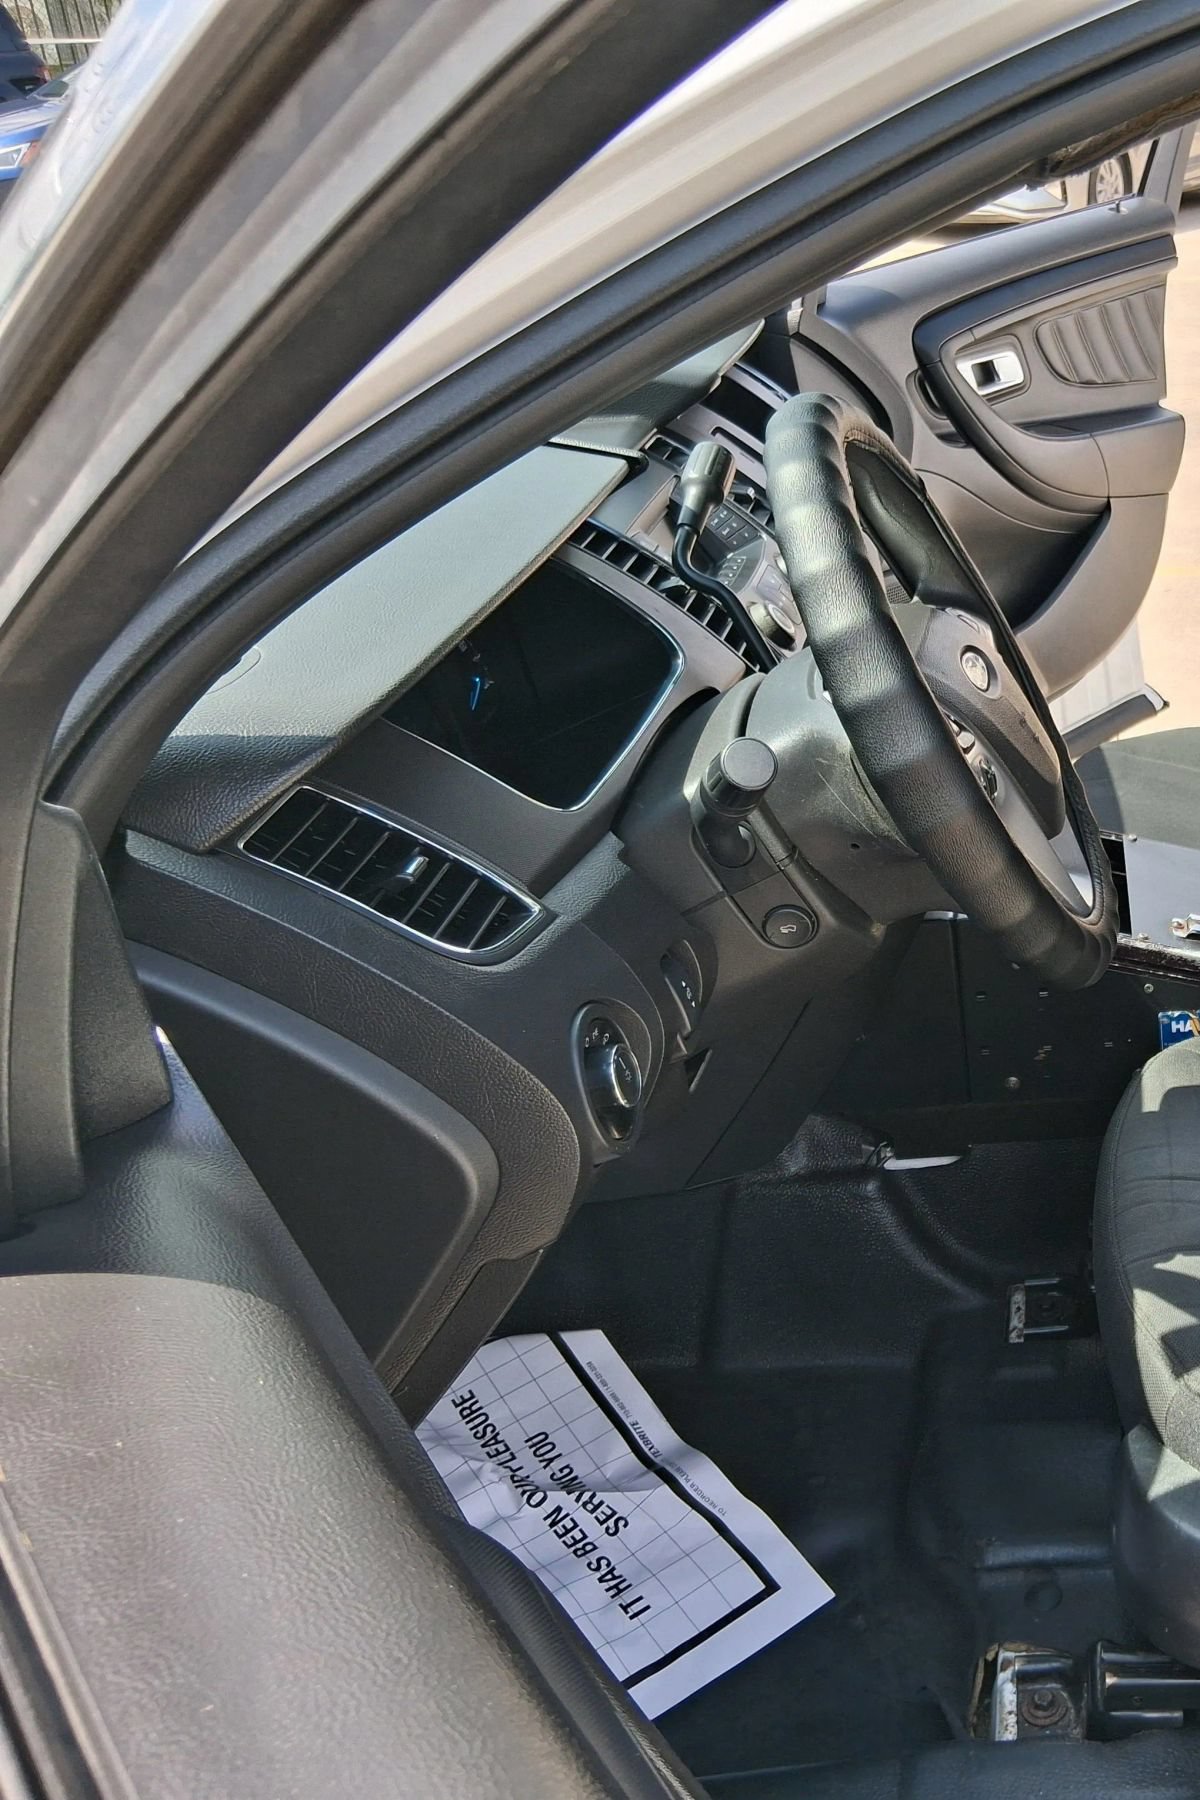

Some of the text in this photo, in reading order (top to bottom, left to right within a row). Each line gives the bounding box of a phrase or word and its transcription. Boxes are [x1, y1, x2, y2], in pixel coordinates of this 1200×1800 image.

[629, 1420, 662, 1459] TEXBRITE
[524, 1429, 630, 1538] SERVING YOU
[688, 1479, 719, 1510] REORDER
[543, 1503, 598, 1560] BEEN
[585, 1554, 632, 1599] HAS
[619, 1593, 651, 1620] IT
